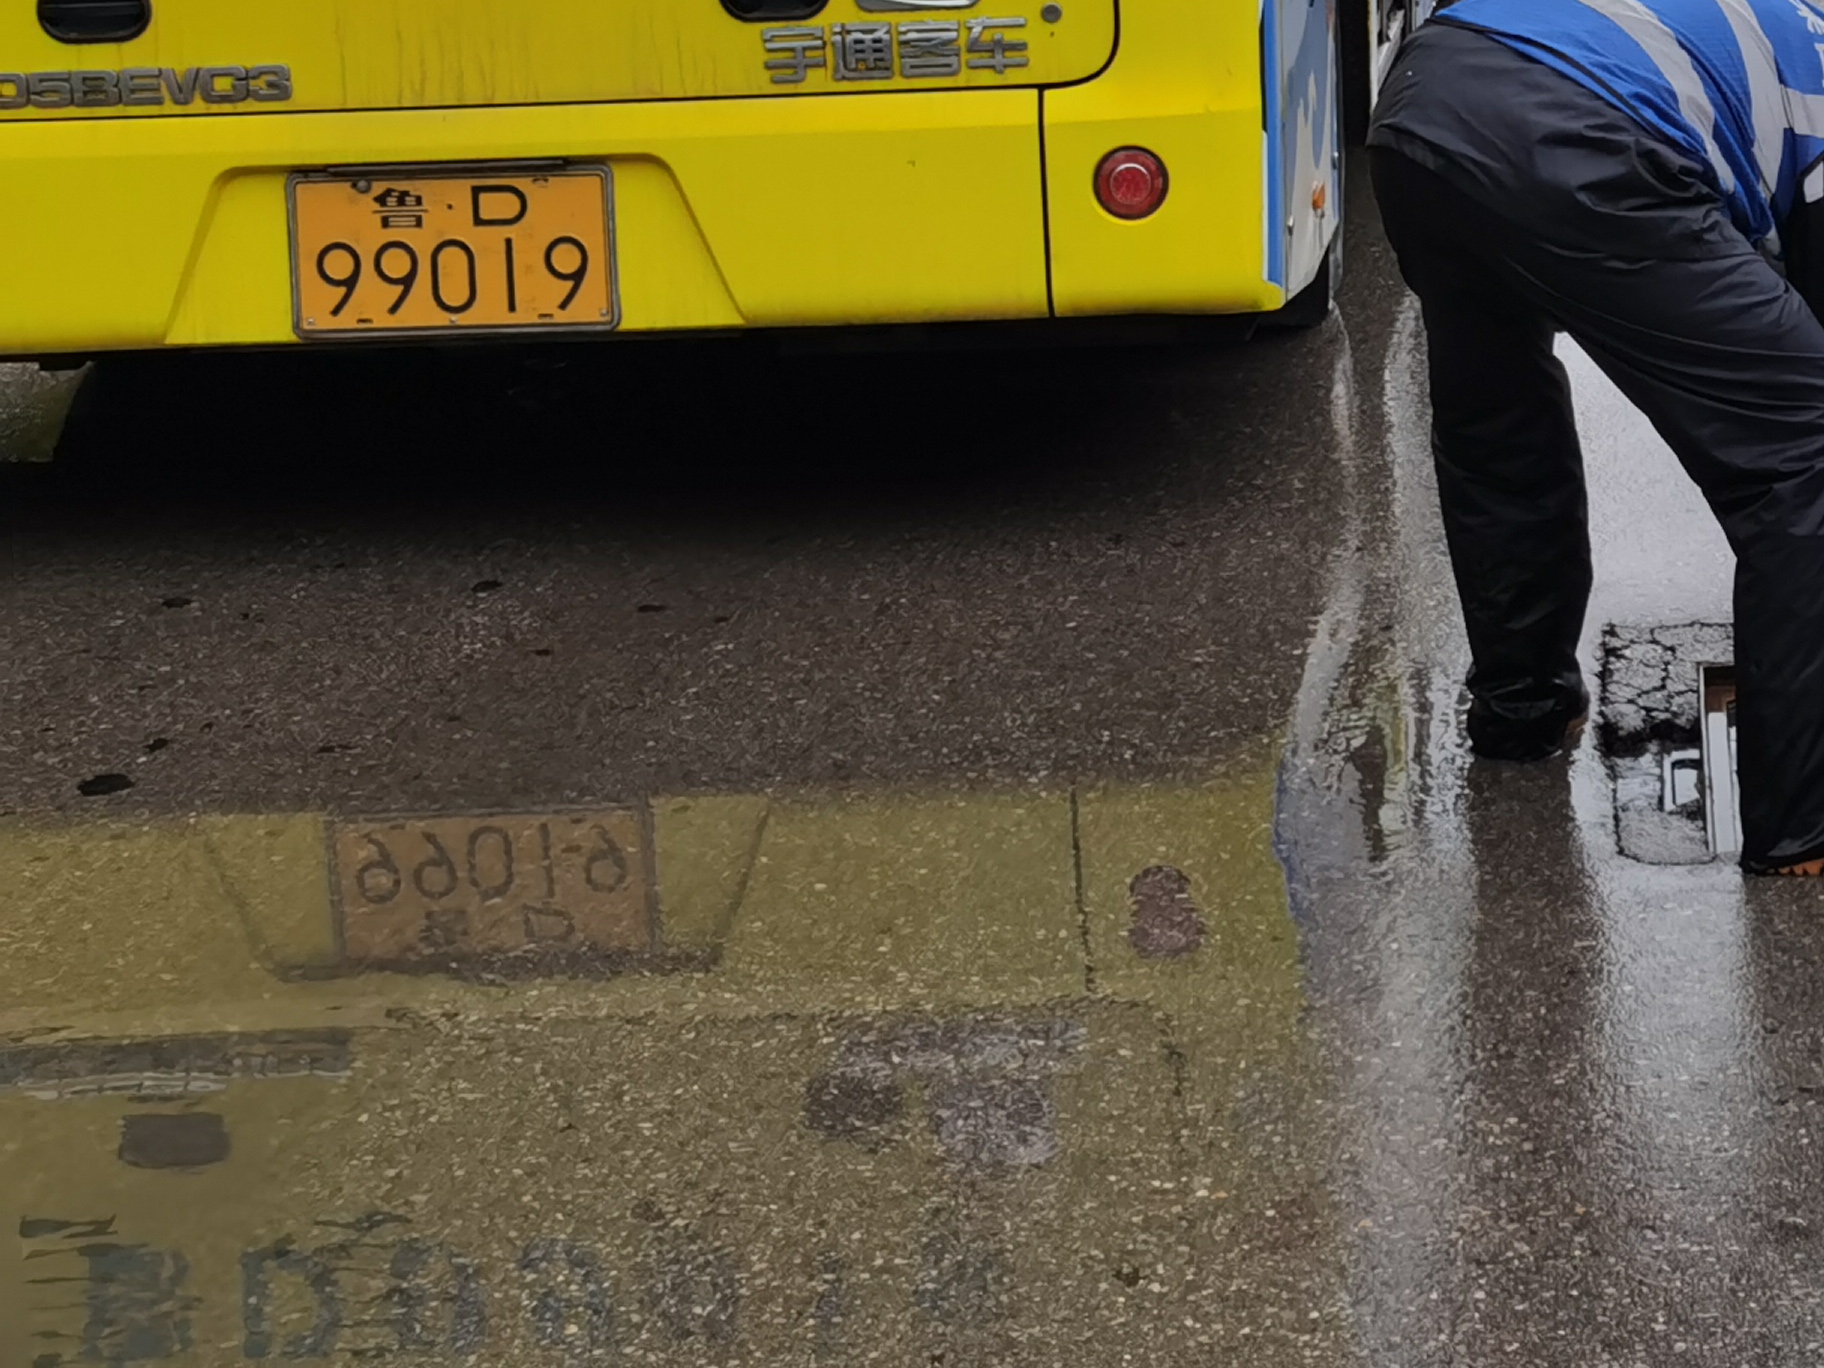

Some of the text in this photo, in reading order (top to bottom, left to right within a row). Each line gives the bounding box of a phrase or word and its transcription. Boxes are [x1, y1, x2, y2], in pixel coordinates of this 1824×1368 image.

[762, 16, 1029, 84] 宇通客车
[316, 235, 588, 317] 99019
